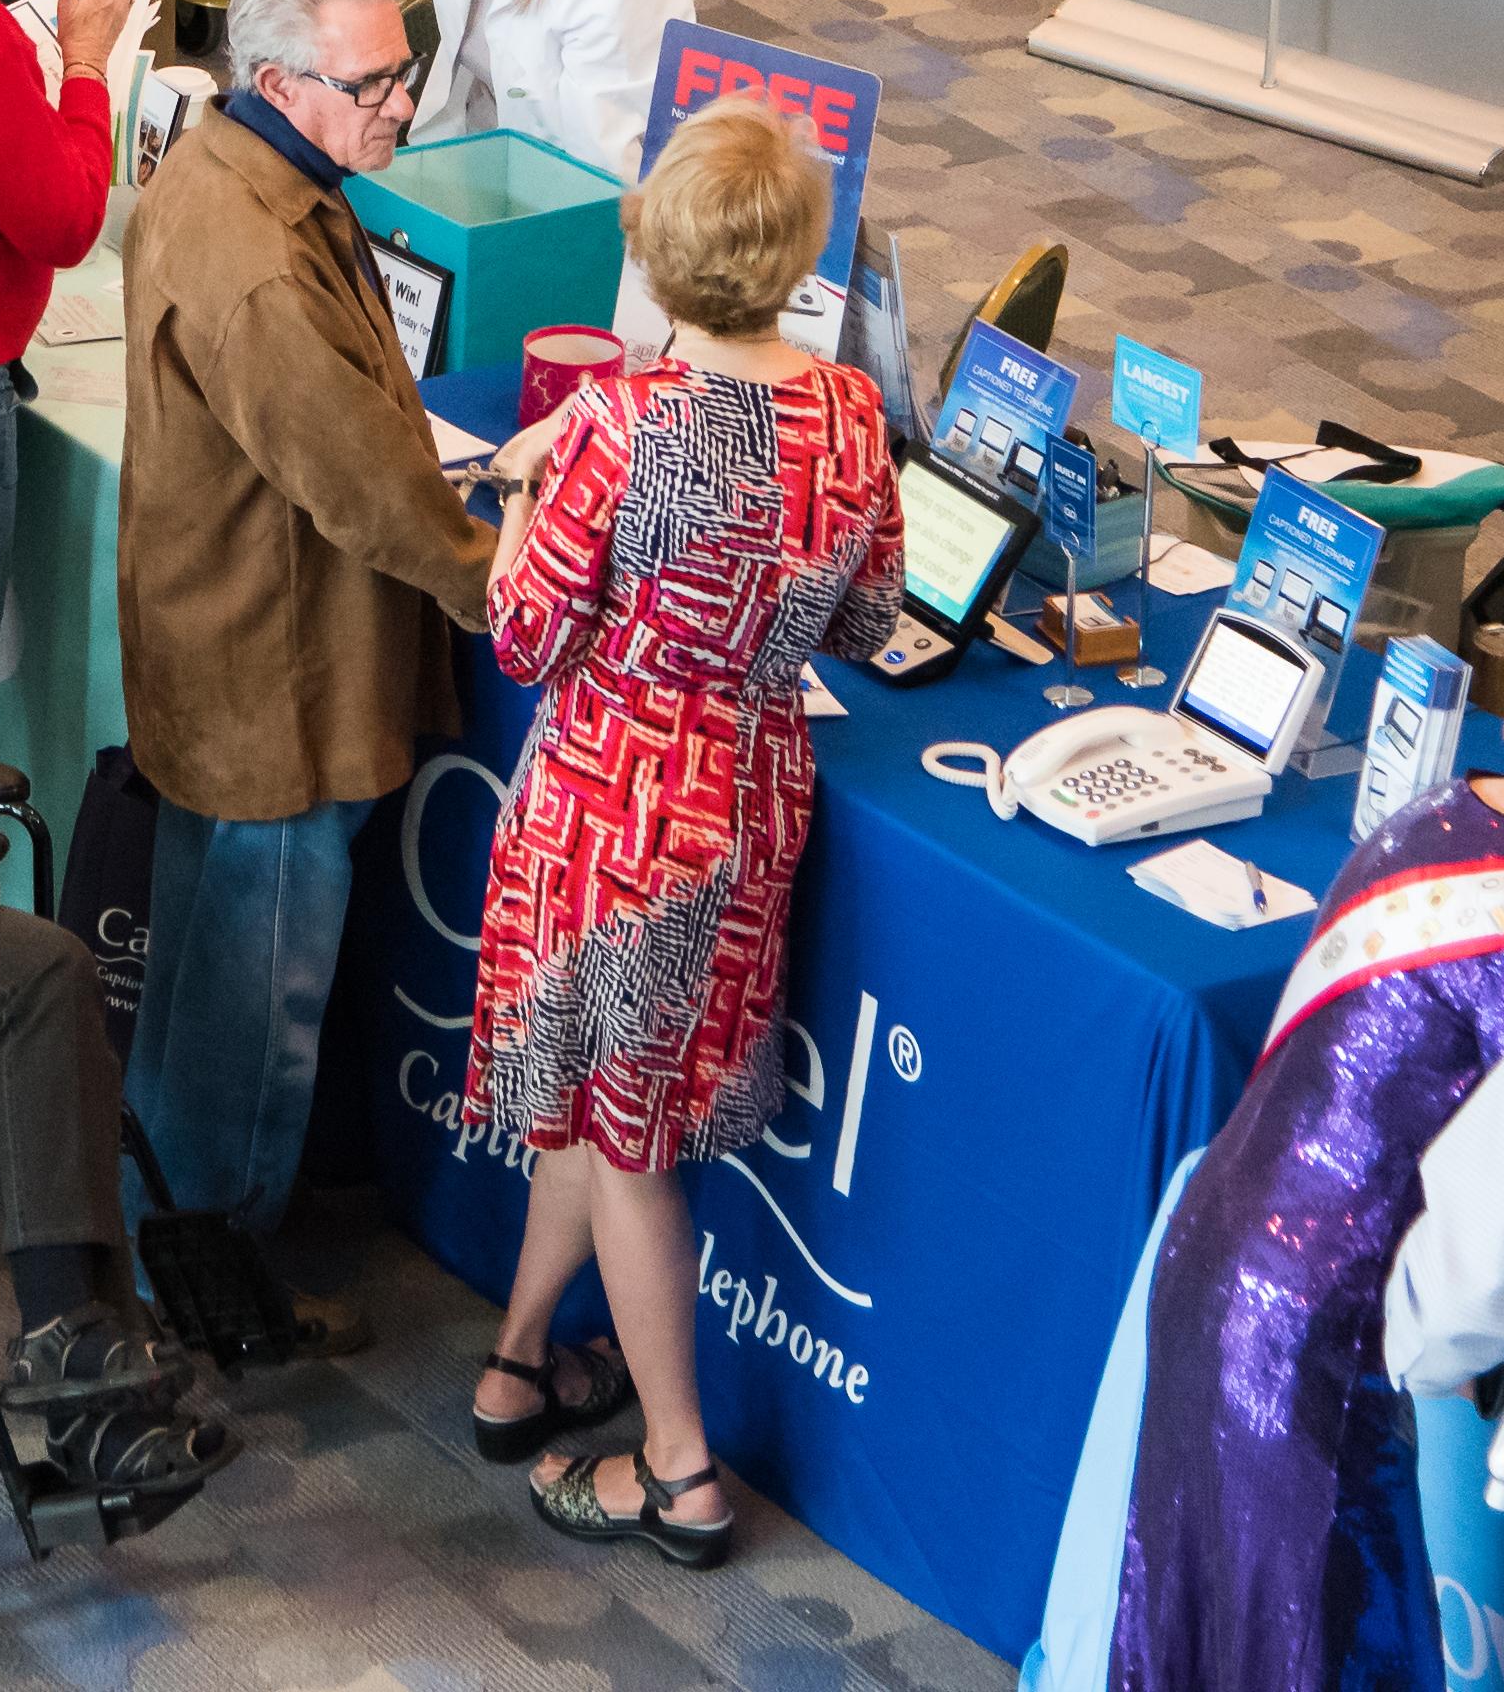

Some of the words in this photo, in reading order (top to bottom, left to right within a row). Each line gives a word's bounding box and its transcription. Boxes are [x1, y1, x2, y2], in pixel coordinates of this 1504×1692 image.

[671, 107, 686, 121] No
[395, 279, 422, 307] Win!
[398, 312, 418, 334] today
[419, 319, 432, 338] for
[410, 345, 419, 358] to
[795, 339, 823, 357] your
[999, 356, 1039, 390] FREE
[1122, 360, 1190, 404] LARGEST
[971, 363, 1012, 398] CAPTIONED
[1013, 383, 1054, 418] TELEPHONE
[1054, 461, 1076, 481] BUILT
[1076, 473, 1087, 487] IN
[1297, 506, 1340, 544] FREE
[1268, 512, 1312, 547] CAPTIONED
[1312, 536, 1357, 572] TELEPHONE
